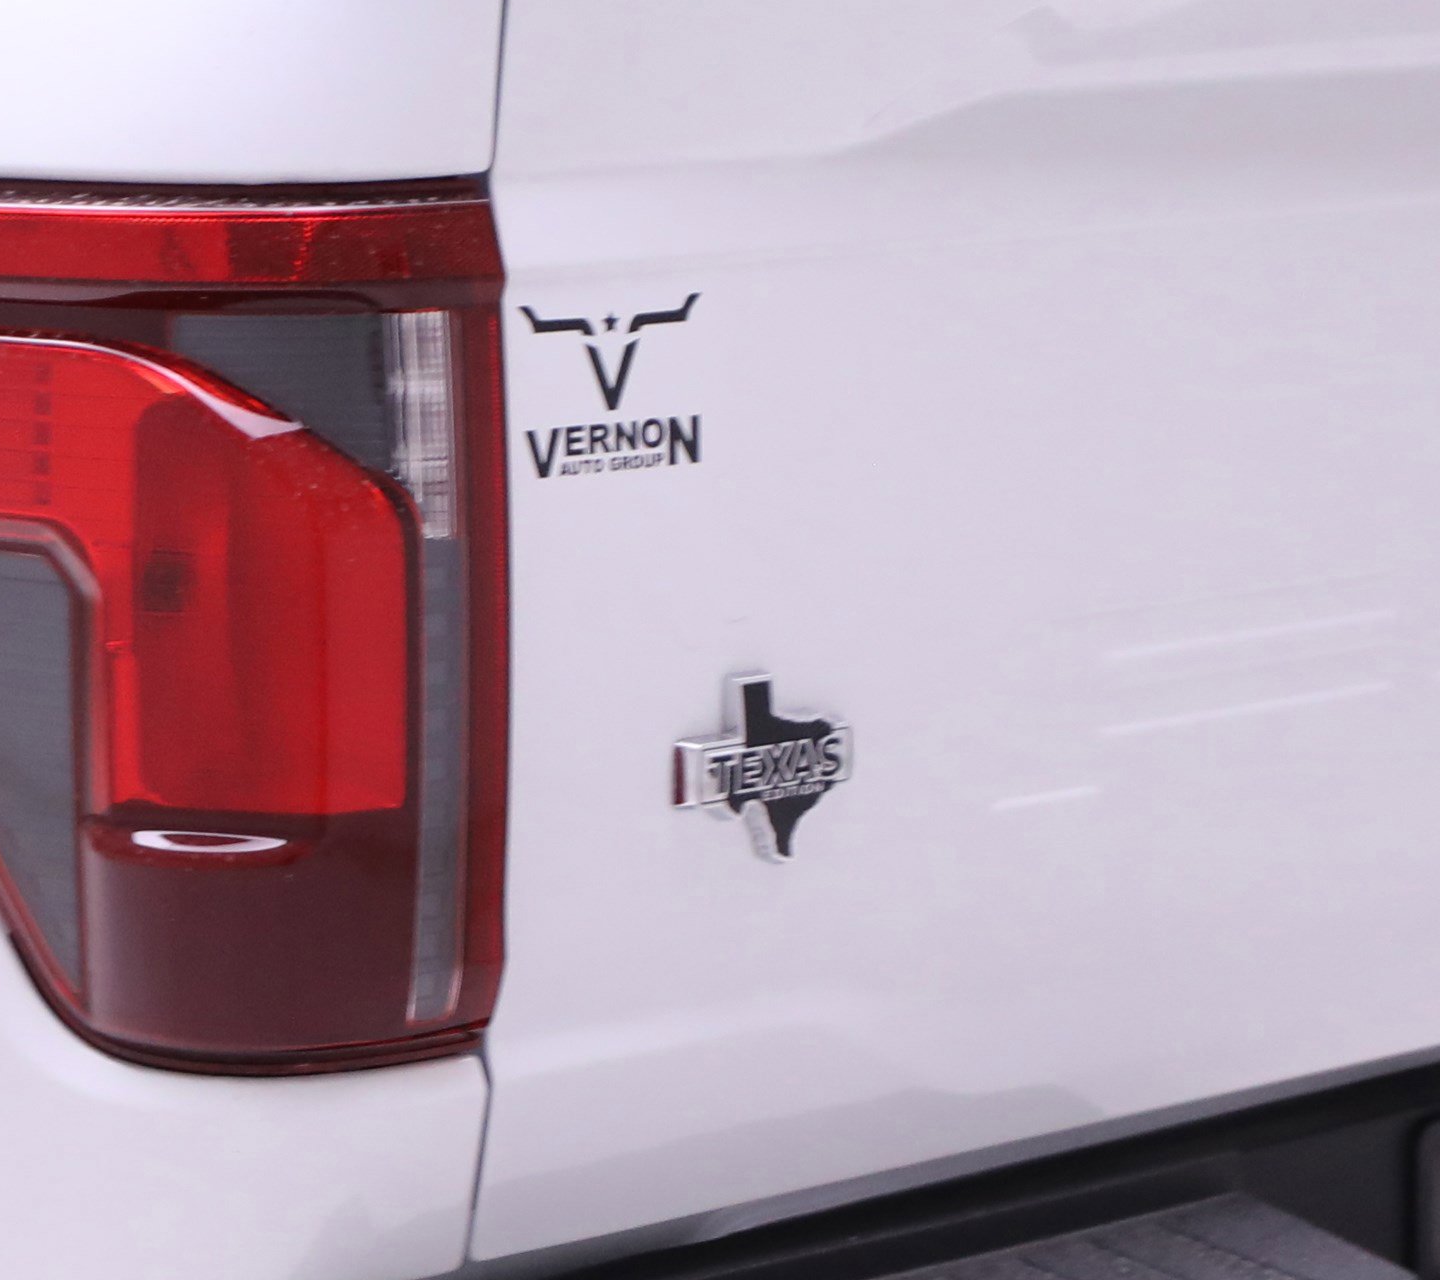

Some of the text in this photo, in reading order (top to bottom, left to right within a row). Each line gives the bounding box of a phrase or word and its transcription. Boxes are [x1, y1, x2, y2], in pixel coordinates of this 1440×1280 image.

[525, 415, 701, 478] VERNON
[559, 452, 665, 476] AUTO GROUP
[708, 737, 842, 794] TEXAS
